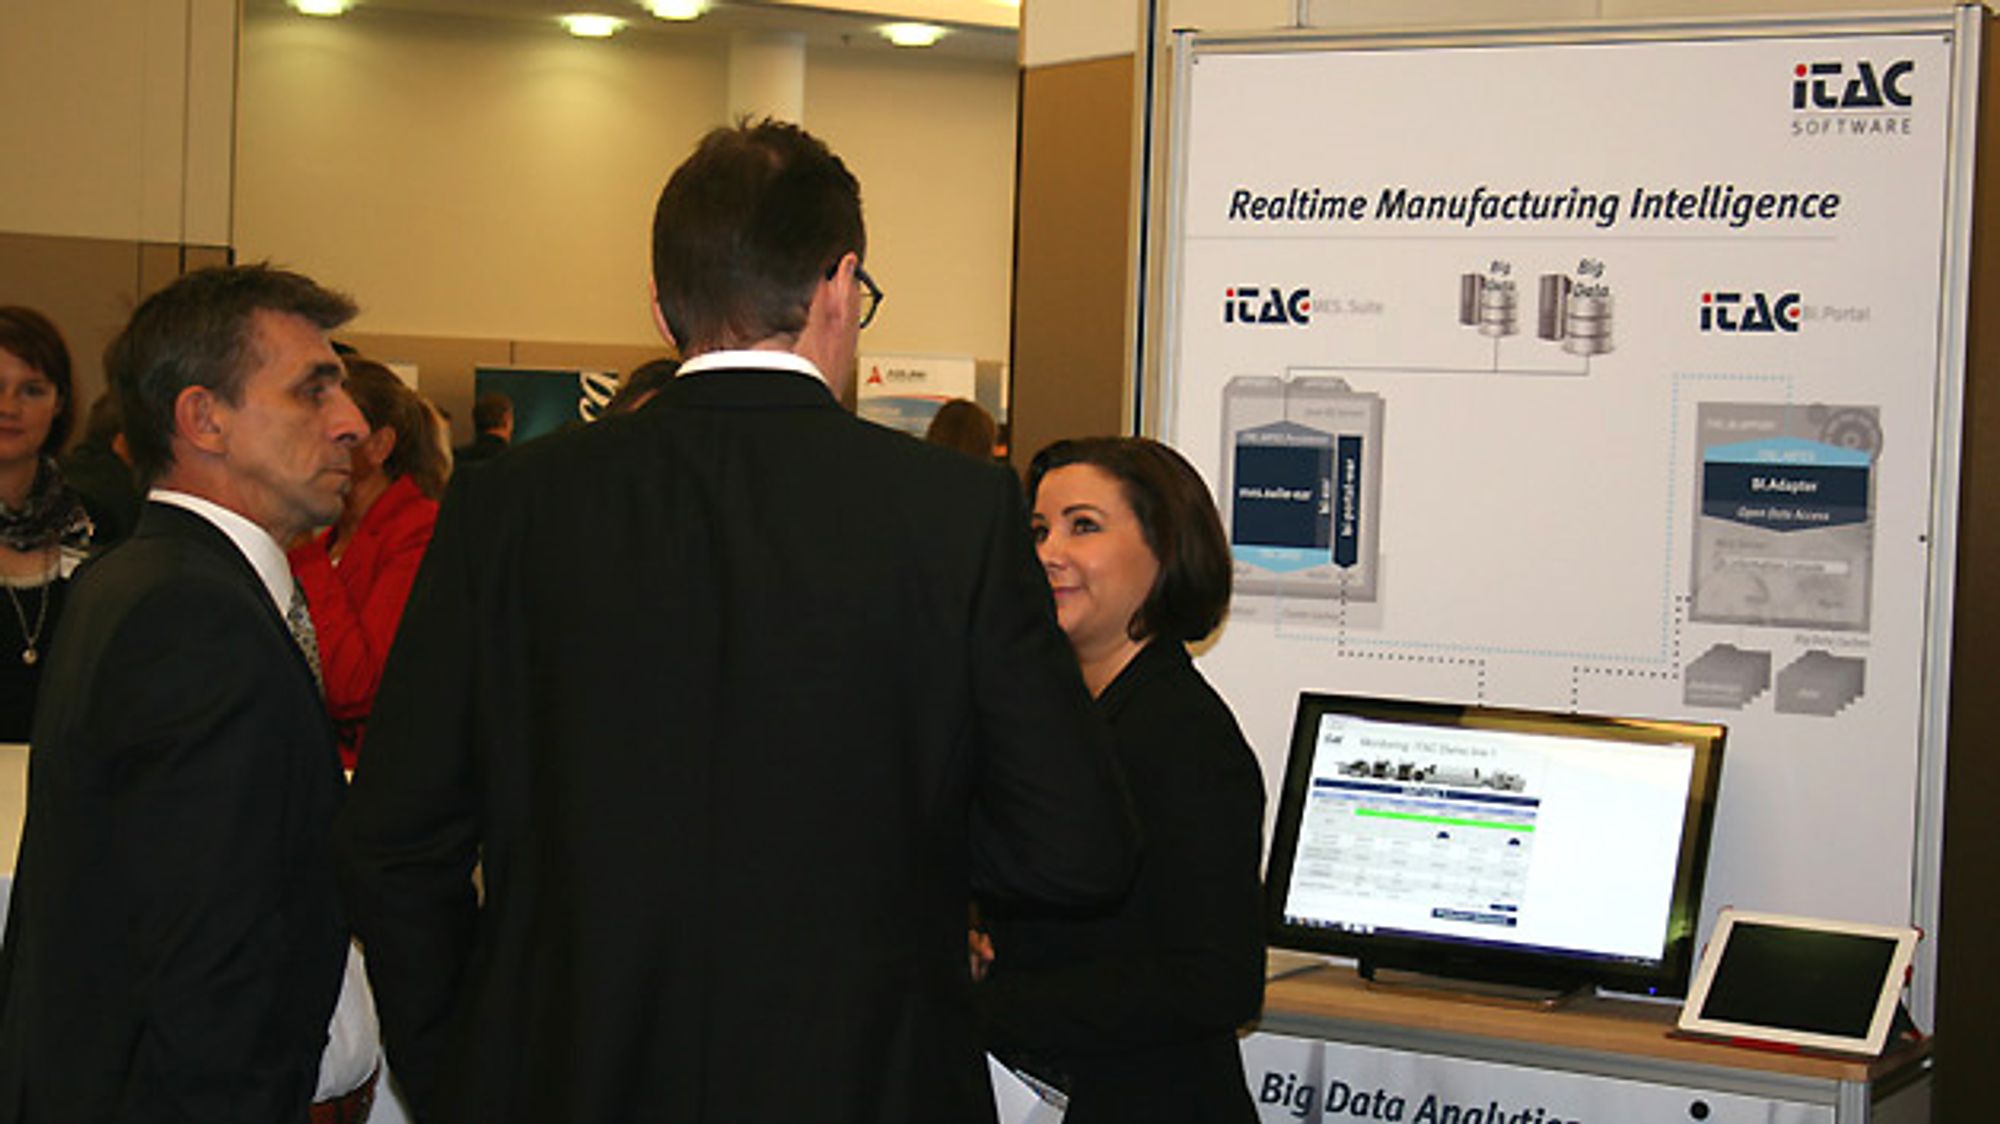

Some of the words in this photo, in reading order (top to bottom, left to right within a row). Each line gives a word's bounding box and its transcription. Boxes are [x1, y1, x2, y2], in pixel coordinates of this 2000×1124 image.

[1791, 118, 1912, 136] SOFTWARE
[1229, 187, 1368, 220] Realtime
[1374, 185, 1620, 228] Manufacturing
[1630, 185, 1841, 228] Intelligence
[1576, 257, 1606, 279] Big
[1572, 282, 1610, 298] Data
[1260, 1071, 1316, 1117] Big
[1325, 1080, 1406, 1122] Data
[1412, 1094, 1582, 1124] Analti
